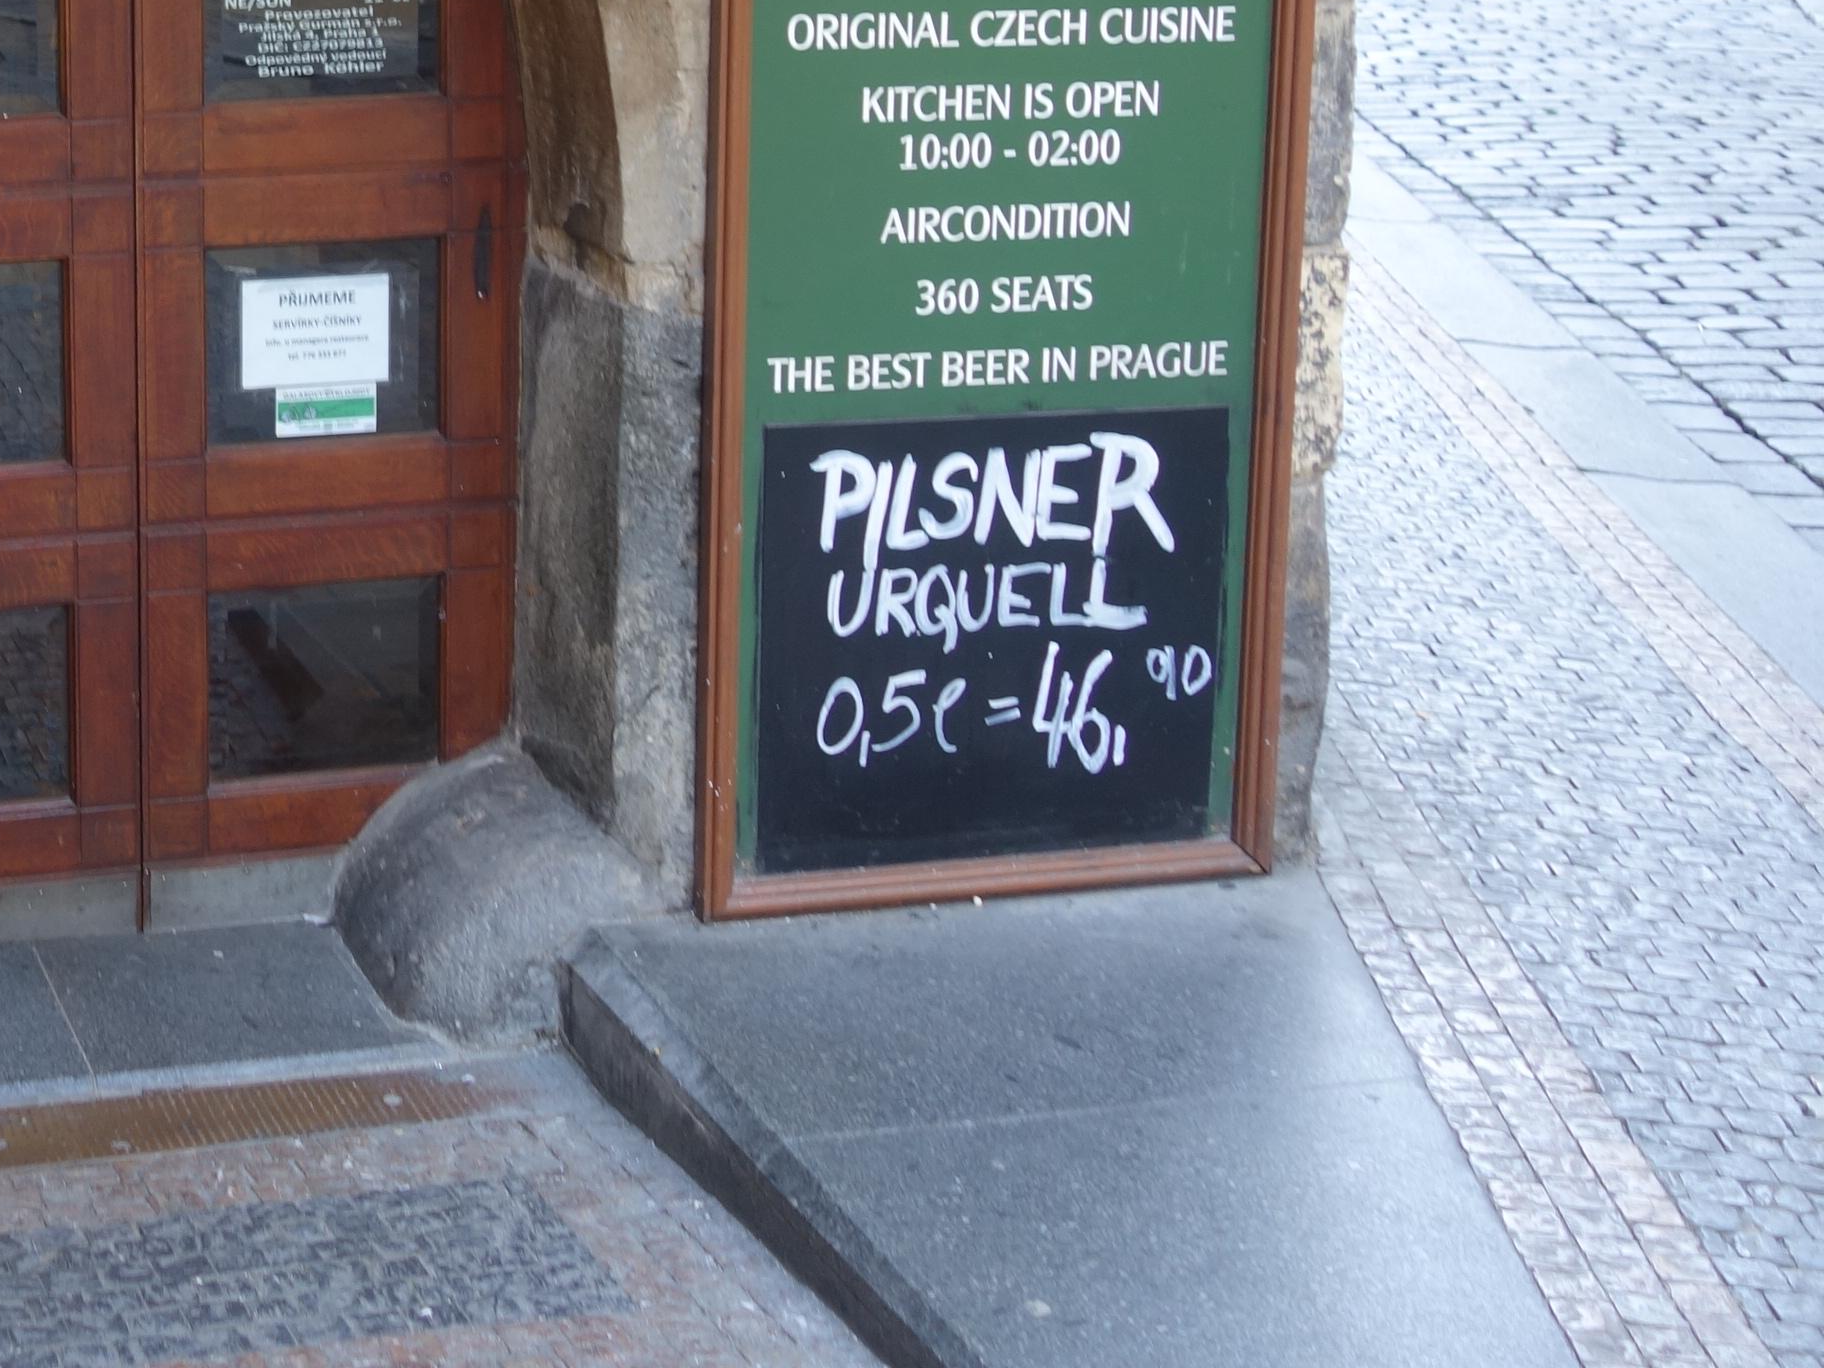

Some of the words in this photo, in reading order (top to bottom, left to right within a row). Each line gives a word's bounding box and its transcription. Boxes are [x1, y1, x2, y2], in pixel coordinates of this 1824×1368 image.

[787, 12, 959, 51] ORIGINAL
[970, 9, 1087, 47] CZECH
[1100, 6, 1236, 44] CUISINE
[258, 65, 314, 78] Bruno
[861, 84, 1010, 123] KITCHEN
[1024, 83, 1054, 119] IS
[1066, 81, 1159, 119] OPEN
[899, 133, 992, 170] 10:00
[1028, 129, 1120, 167] 02:00
[881, 201, 1130, 244] AIRCONDITION
[279, 288, 357, 308] PŘIJMEME
[915, 278, 978, 316] 360
[991, 274, 1093, 312] SEATS
[767, 355, 835, 393] THE
[847, 352, 931, 390] BEST
[941, 349, 1029, 387] BEER
[1042, 347, 1076, 383] IN
[1090, 341, 1228, 380] PRAGUE
[810, 432, 1175, 572] PILSNER
[827, 559, 1147, 654] URQUELL
